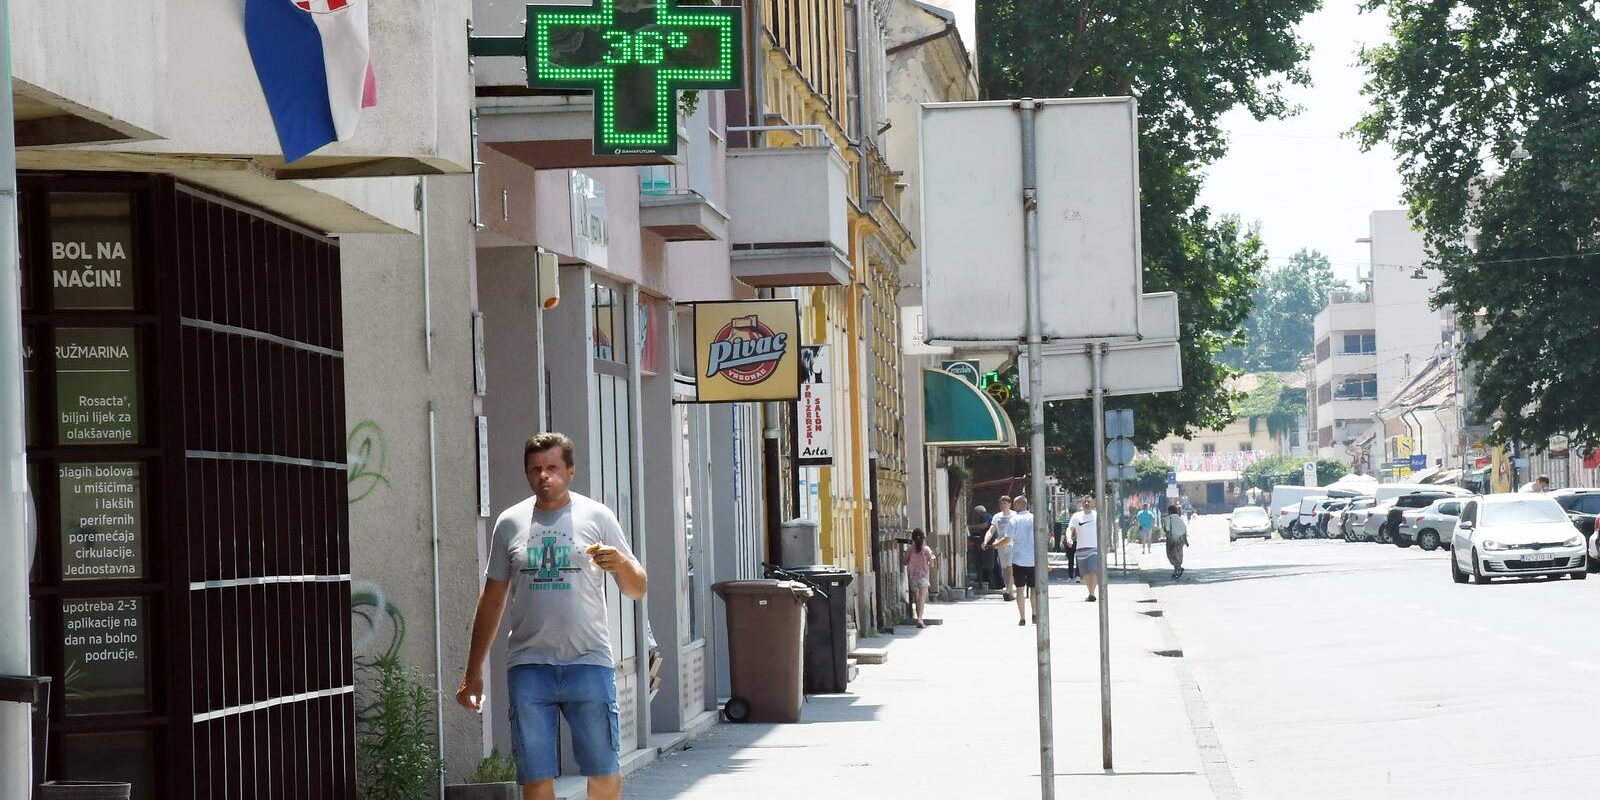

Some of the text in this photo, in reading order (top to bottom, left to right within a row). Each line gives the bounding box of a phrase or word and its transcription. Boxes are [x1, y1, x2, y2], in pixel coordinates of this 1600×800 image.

[51, 241, 127, 260] BOL NA
[53, 264, 122, 288] NAČIN!
[55, 342, 129, 359] RUŽMARINA
[706, 332, 788, 378] Pivac
[61, 410, 132, 425] biljni lijek za
[804, 384, 814, 445] FRIZERSKI
[814, 397, 823, 432] SALON
[66, 427, 132, 441] olakšavanje
[802, 446, 828, 456] Arta
[95, 465, 133, 477] bolova
[74, 481, 134, 494] u mišićima
[95, 497, 134, 509] i lakših
[80, 513, 134, 528] perifernih
[69, 529, 135, 545] poremećaja
[75, 546, 135, 560] cirkulacije.
[64, 563, 136, 575] Jednostavna
[62, 599, 137, 615] upotreba 2-3
[67, 615, 137, 631] aplikacije na
[64, 632, 138, 646] dan na bolno
[85, 648, 138, 664] područje.
